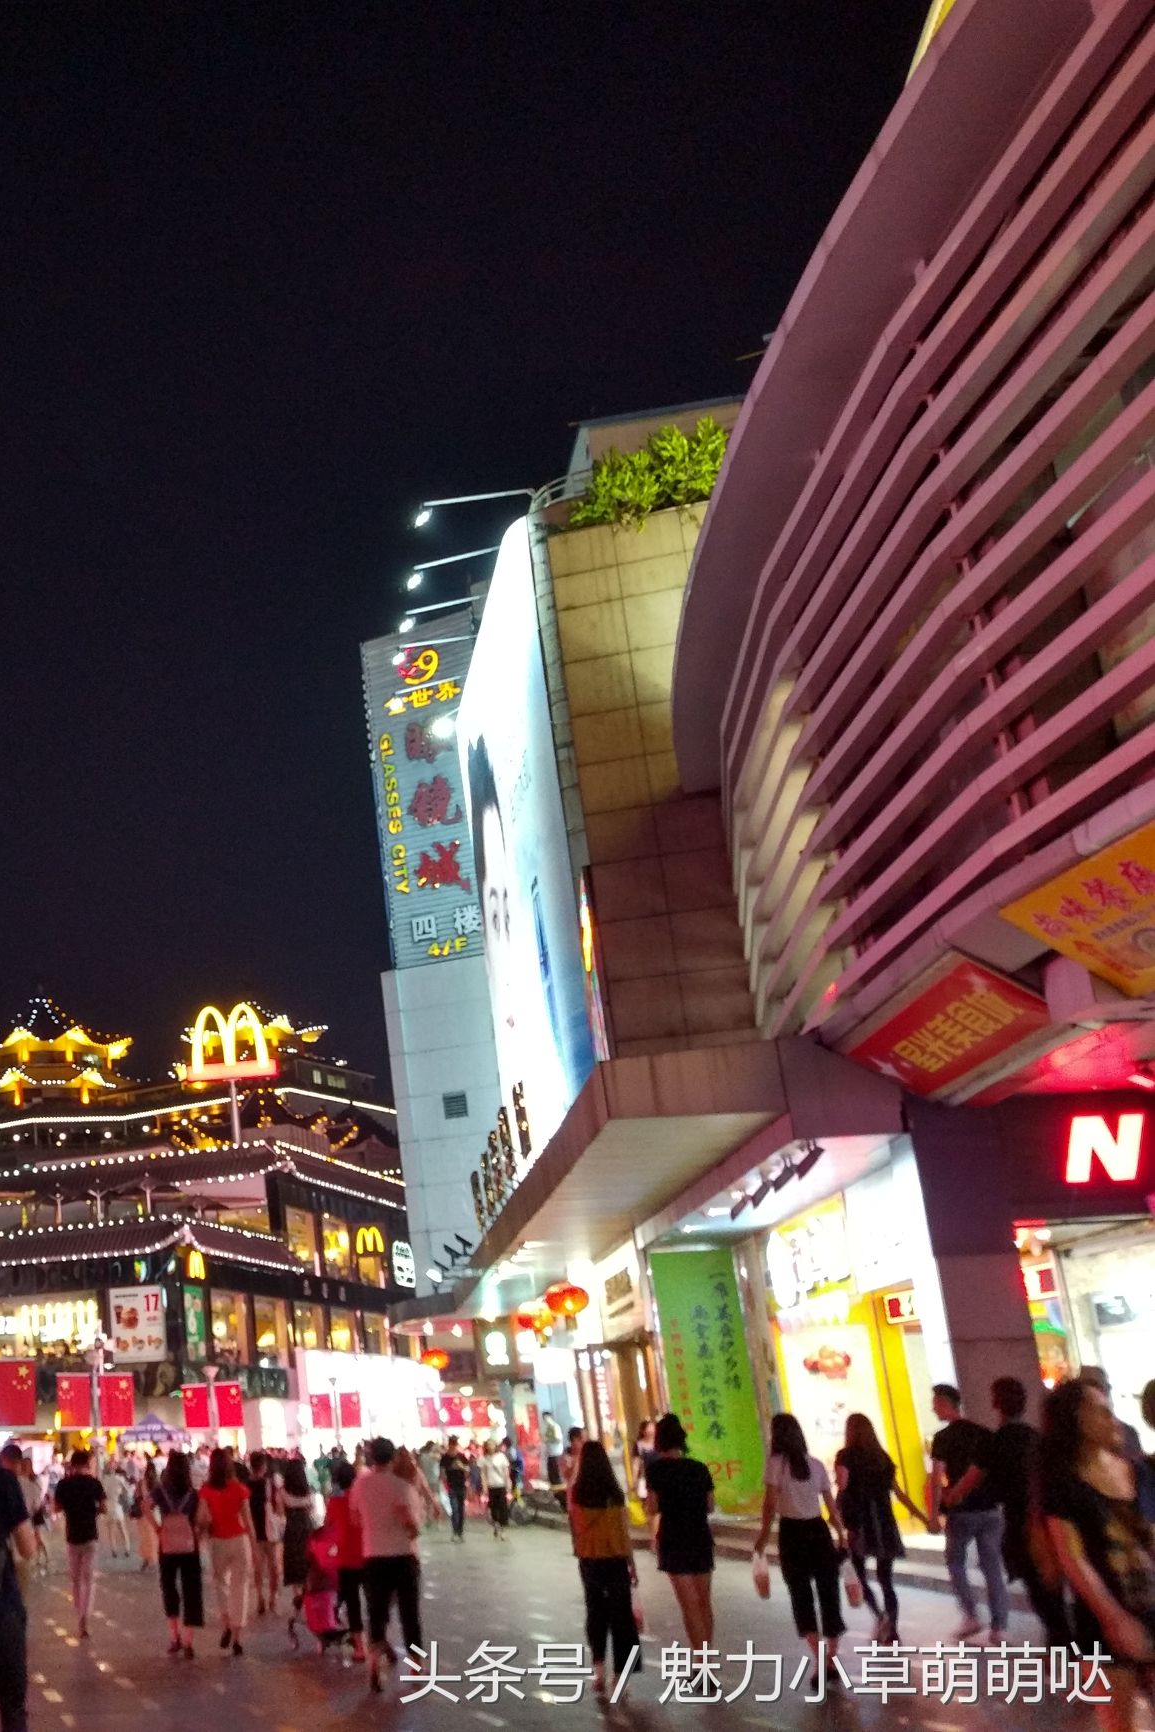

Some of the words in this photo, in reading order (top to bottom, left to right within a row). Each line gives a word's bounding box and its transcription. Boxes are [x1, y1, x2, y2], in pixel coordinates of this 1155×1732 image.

[378, 732, 403, 835] GLASSES
[391, 844, 411, 895] CITY
[1066, 1113, 1144, 1185] N
